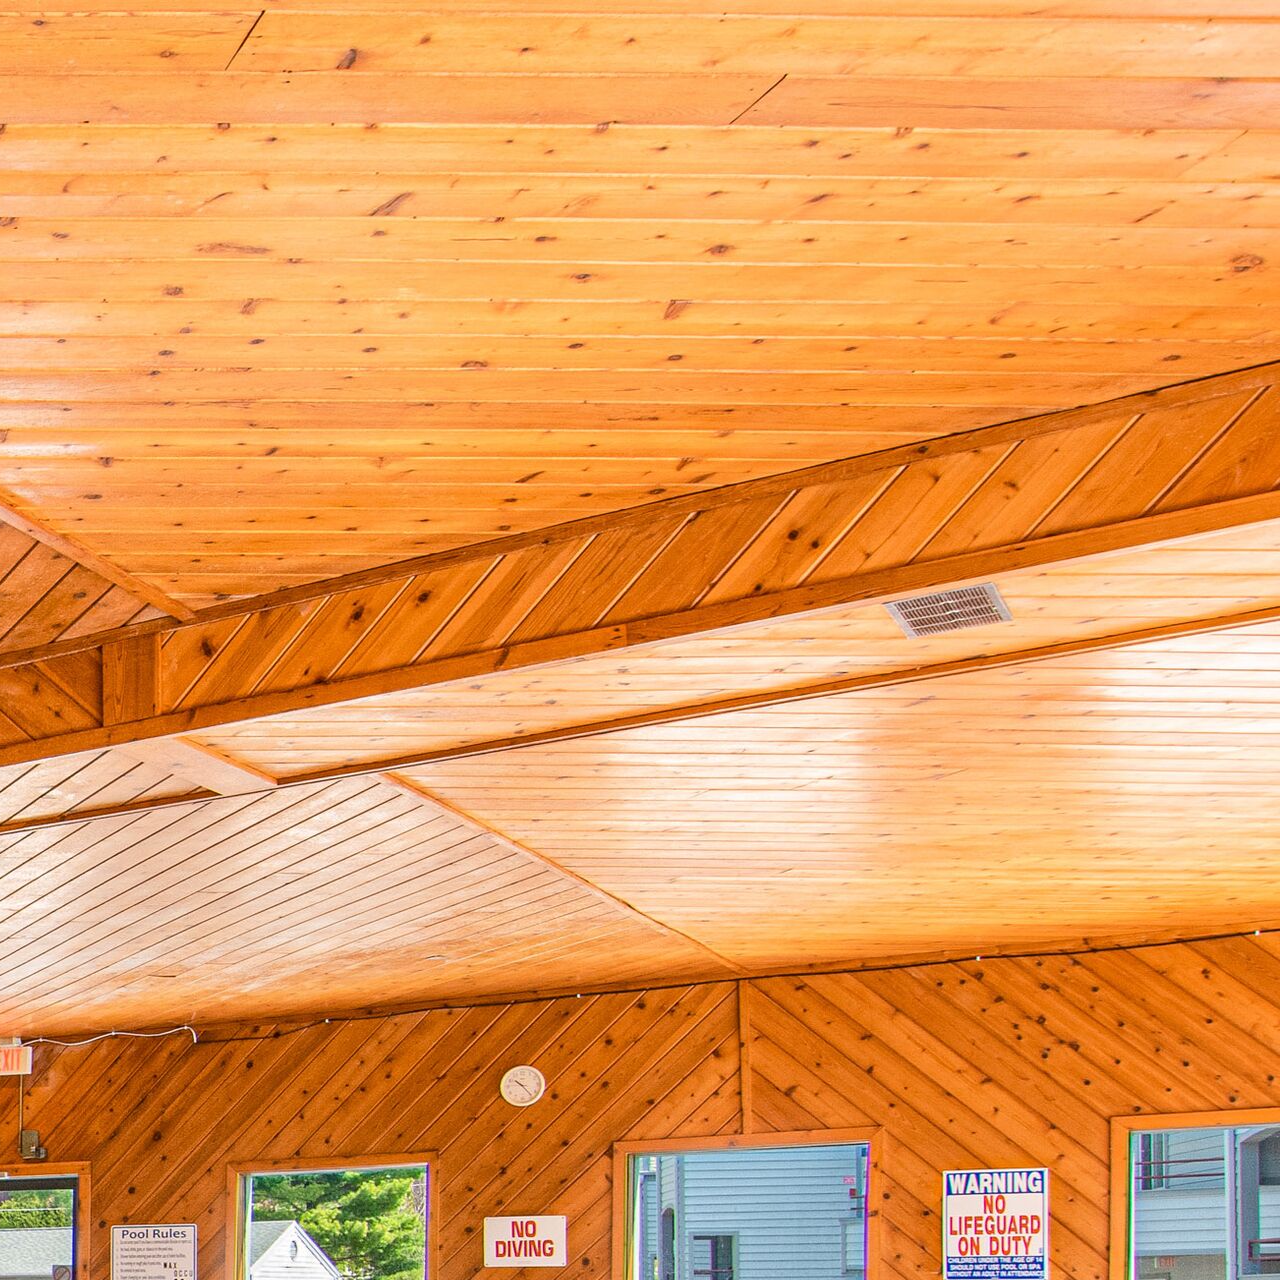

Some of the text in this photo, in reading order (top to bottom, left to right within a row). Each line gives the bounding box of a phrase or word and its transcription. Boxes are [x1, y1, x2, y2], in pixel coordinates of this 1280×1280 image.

[948, 1171, 1043, 1194] WARNING
[984, 1195, 1006, 1214] NO
[122, 1228, 187, 1239] Pool Rules
[511, 1220, 536, 1238] NO
[949, 1215, 1041, 1236] LIFEGUARD
[495, 1240, 554, 1258] DIVING
[958, 1236, 1032, 1256] ON DUTY
